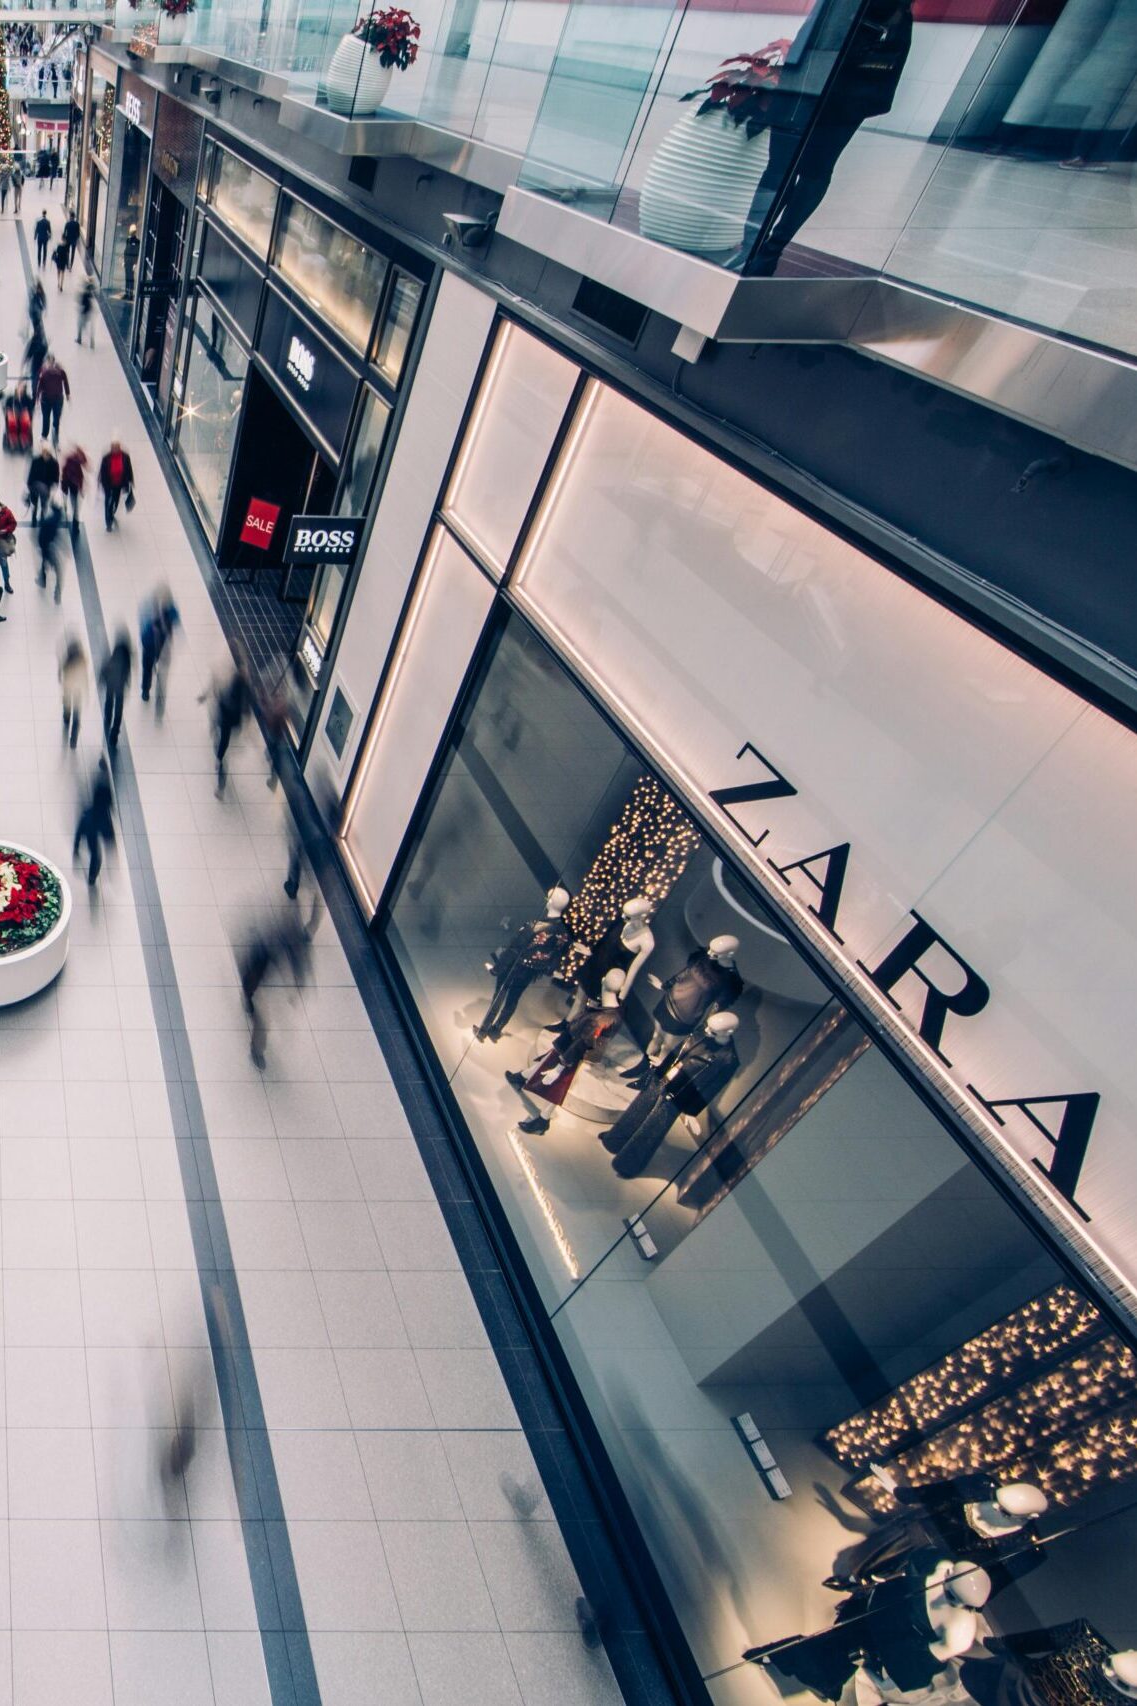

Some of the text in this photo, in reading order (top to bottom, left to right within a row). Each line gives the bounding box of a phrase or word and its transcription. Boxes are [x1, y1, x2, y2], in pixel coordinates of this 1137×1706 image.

[246, 515, 274, 534] SALE
[294, 529, 354, 548] BOSS
[708, 742, 1101, 1223] ZARA
